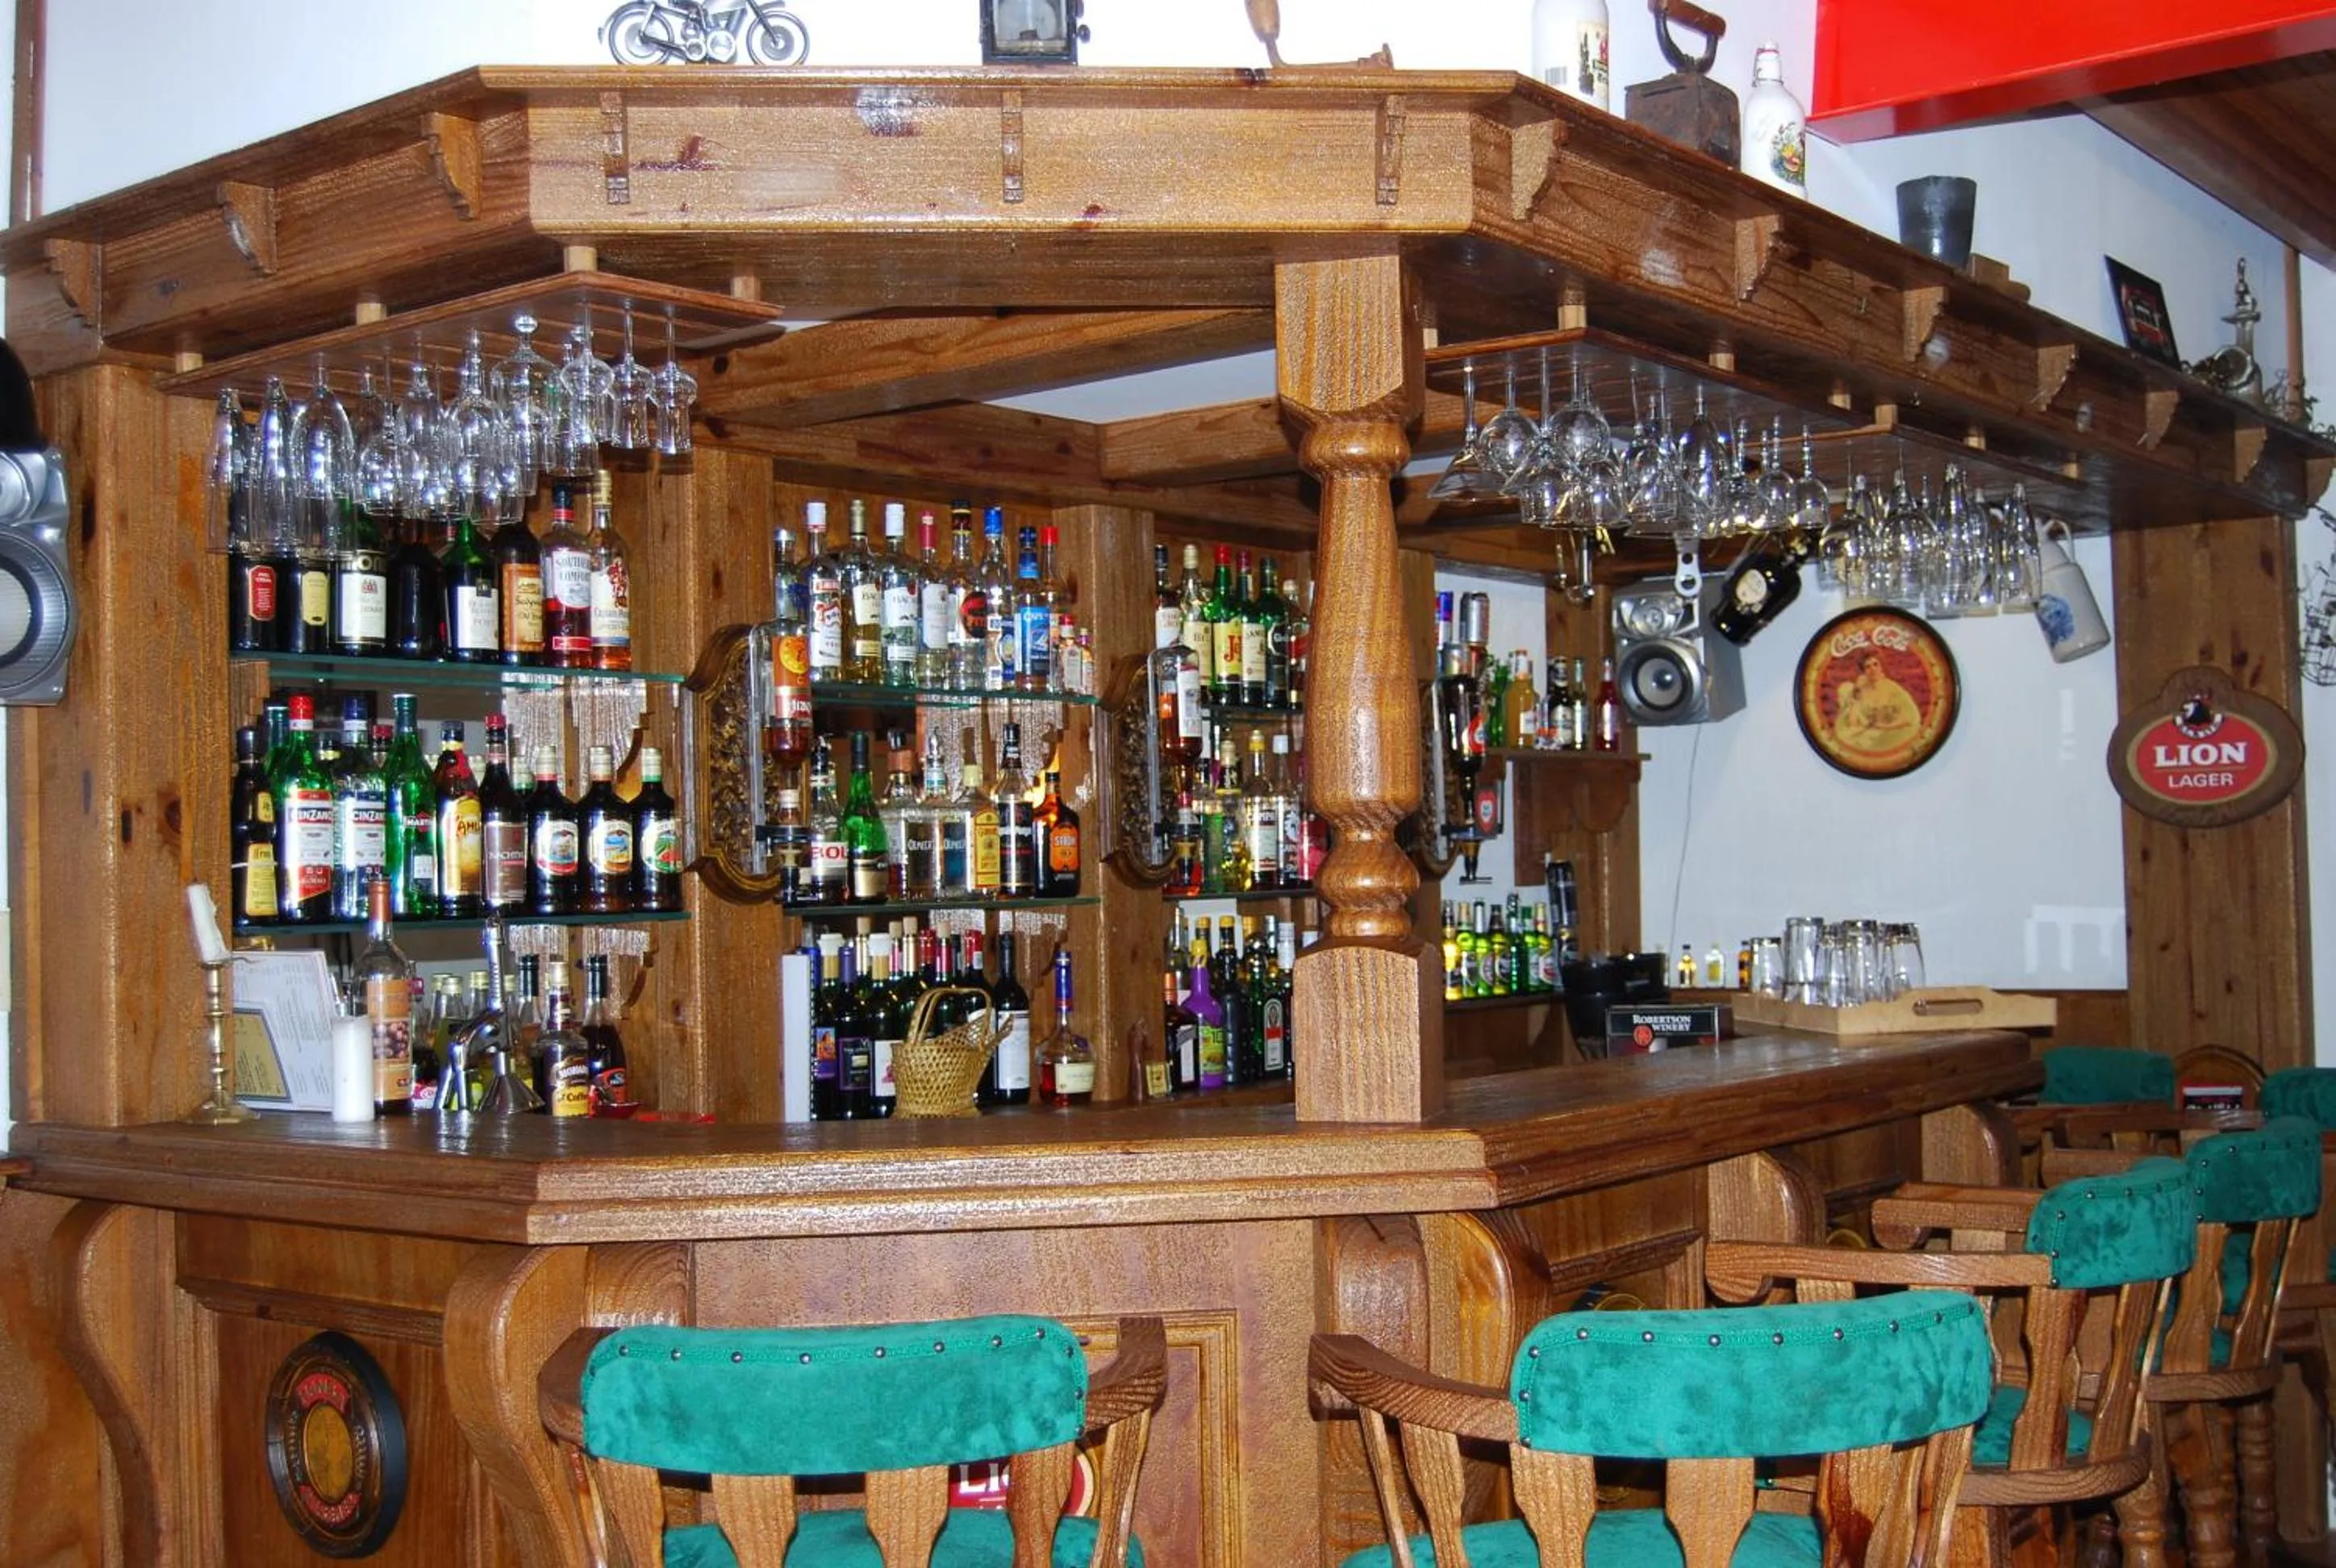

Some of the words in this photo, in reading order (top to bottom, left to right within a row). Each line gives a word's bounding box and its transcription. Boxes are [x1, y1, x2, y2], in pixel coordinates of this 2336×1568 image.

[2154, 742, 2247, 767] LION
[2167, 772, 2234, 789] LAGER
[811, 845, 847, 860] BOL
[1633, 1015, 1692, 1024] ROBERTSON
[1651, 1024, 1691, 1032] WINERY
[958, 1463, 1010, 1495] LI
